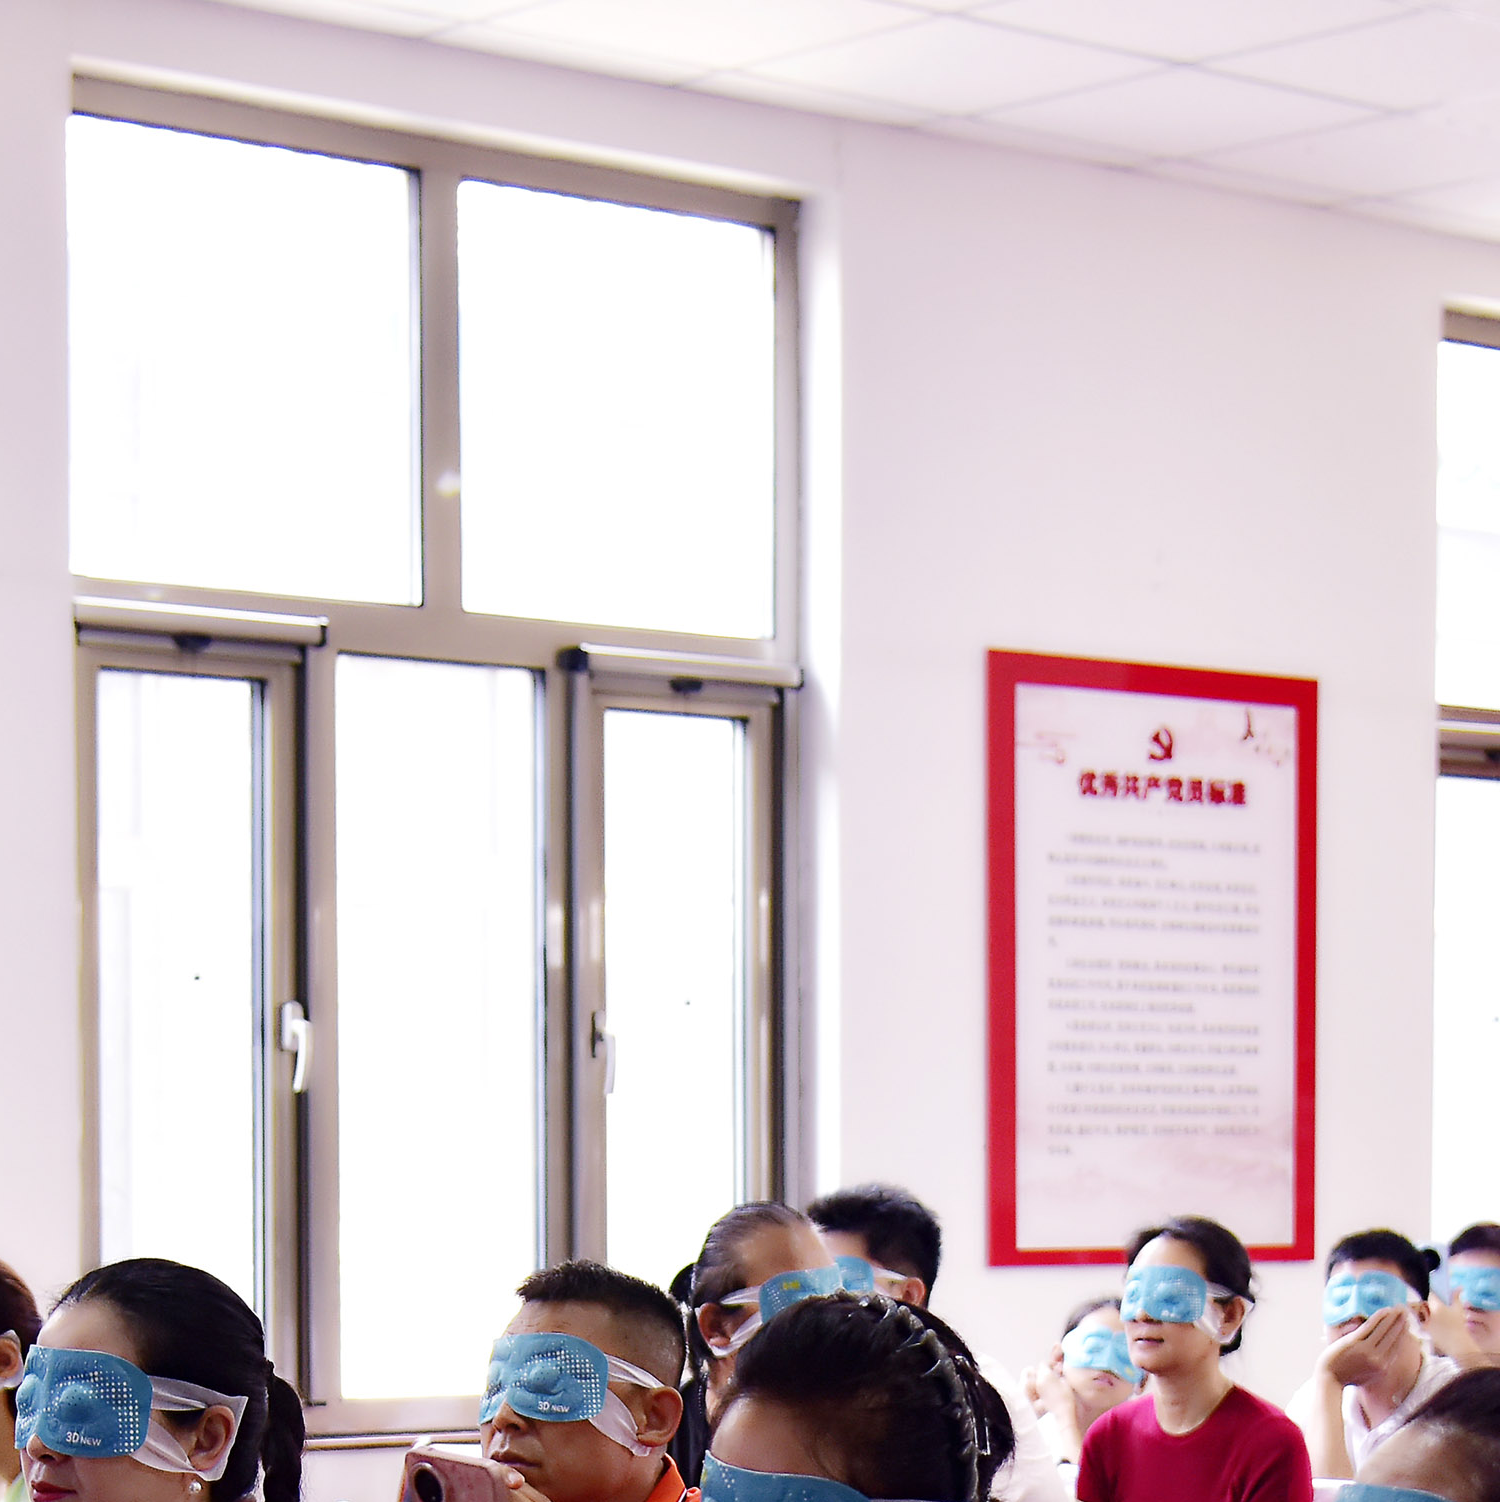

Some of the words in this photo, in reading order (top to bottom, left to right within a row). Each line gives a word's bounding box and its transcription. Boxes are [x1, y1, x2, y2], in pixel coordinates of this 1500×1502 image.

[538, 1401, 550, 1411] 3D
[66, 1431, 79, 1443] 3D
[80, 1436, 101, 1446] NEW
